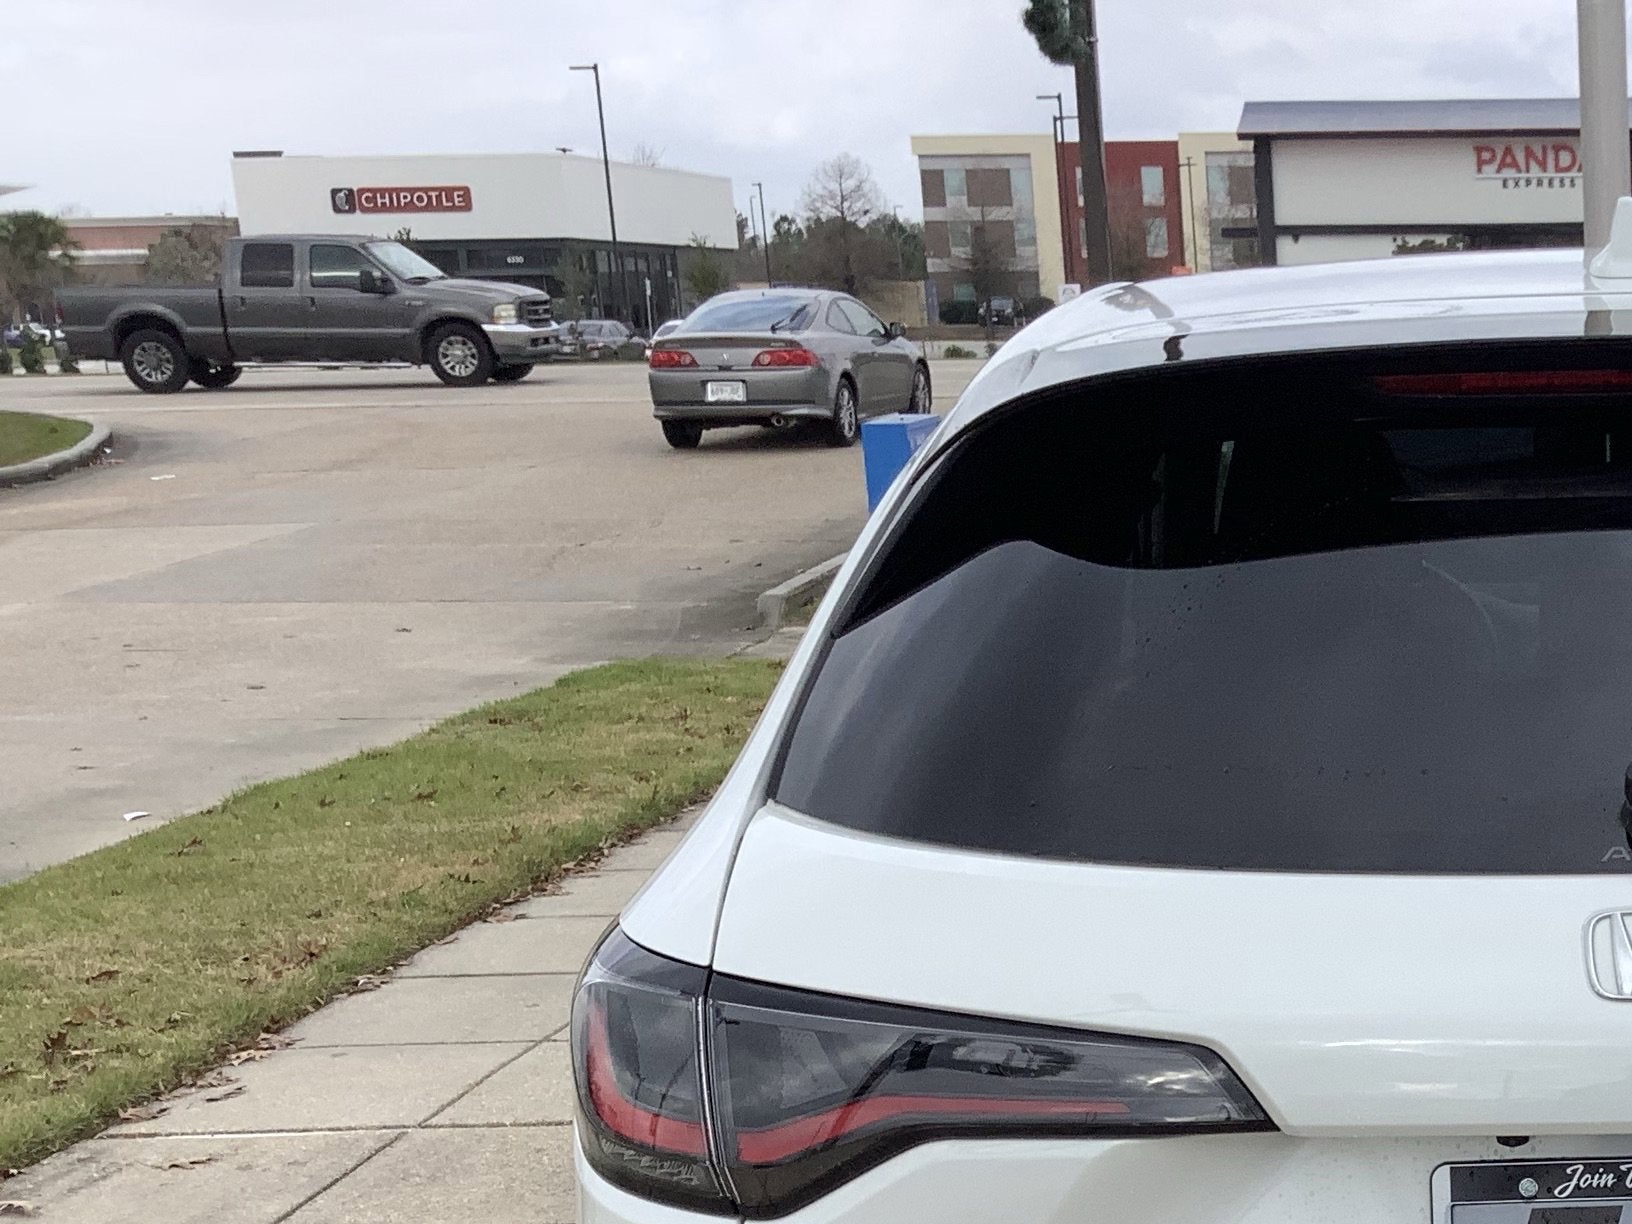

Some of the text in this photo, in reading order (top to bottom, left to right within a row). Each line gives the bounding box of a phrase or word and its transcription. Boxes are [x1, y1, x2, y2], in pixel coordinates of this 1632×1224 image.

[1502, 177, 1576, 189] EXPRESS
[360, 190, 467, 208] CHIPOTLE
[1553, 1163, 1617, 1198] Join
